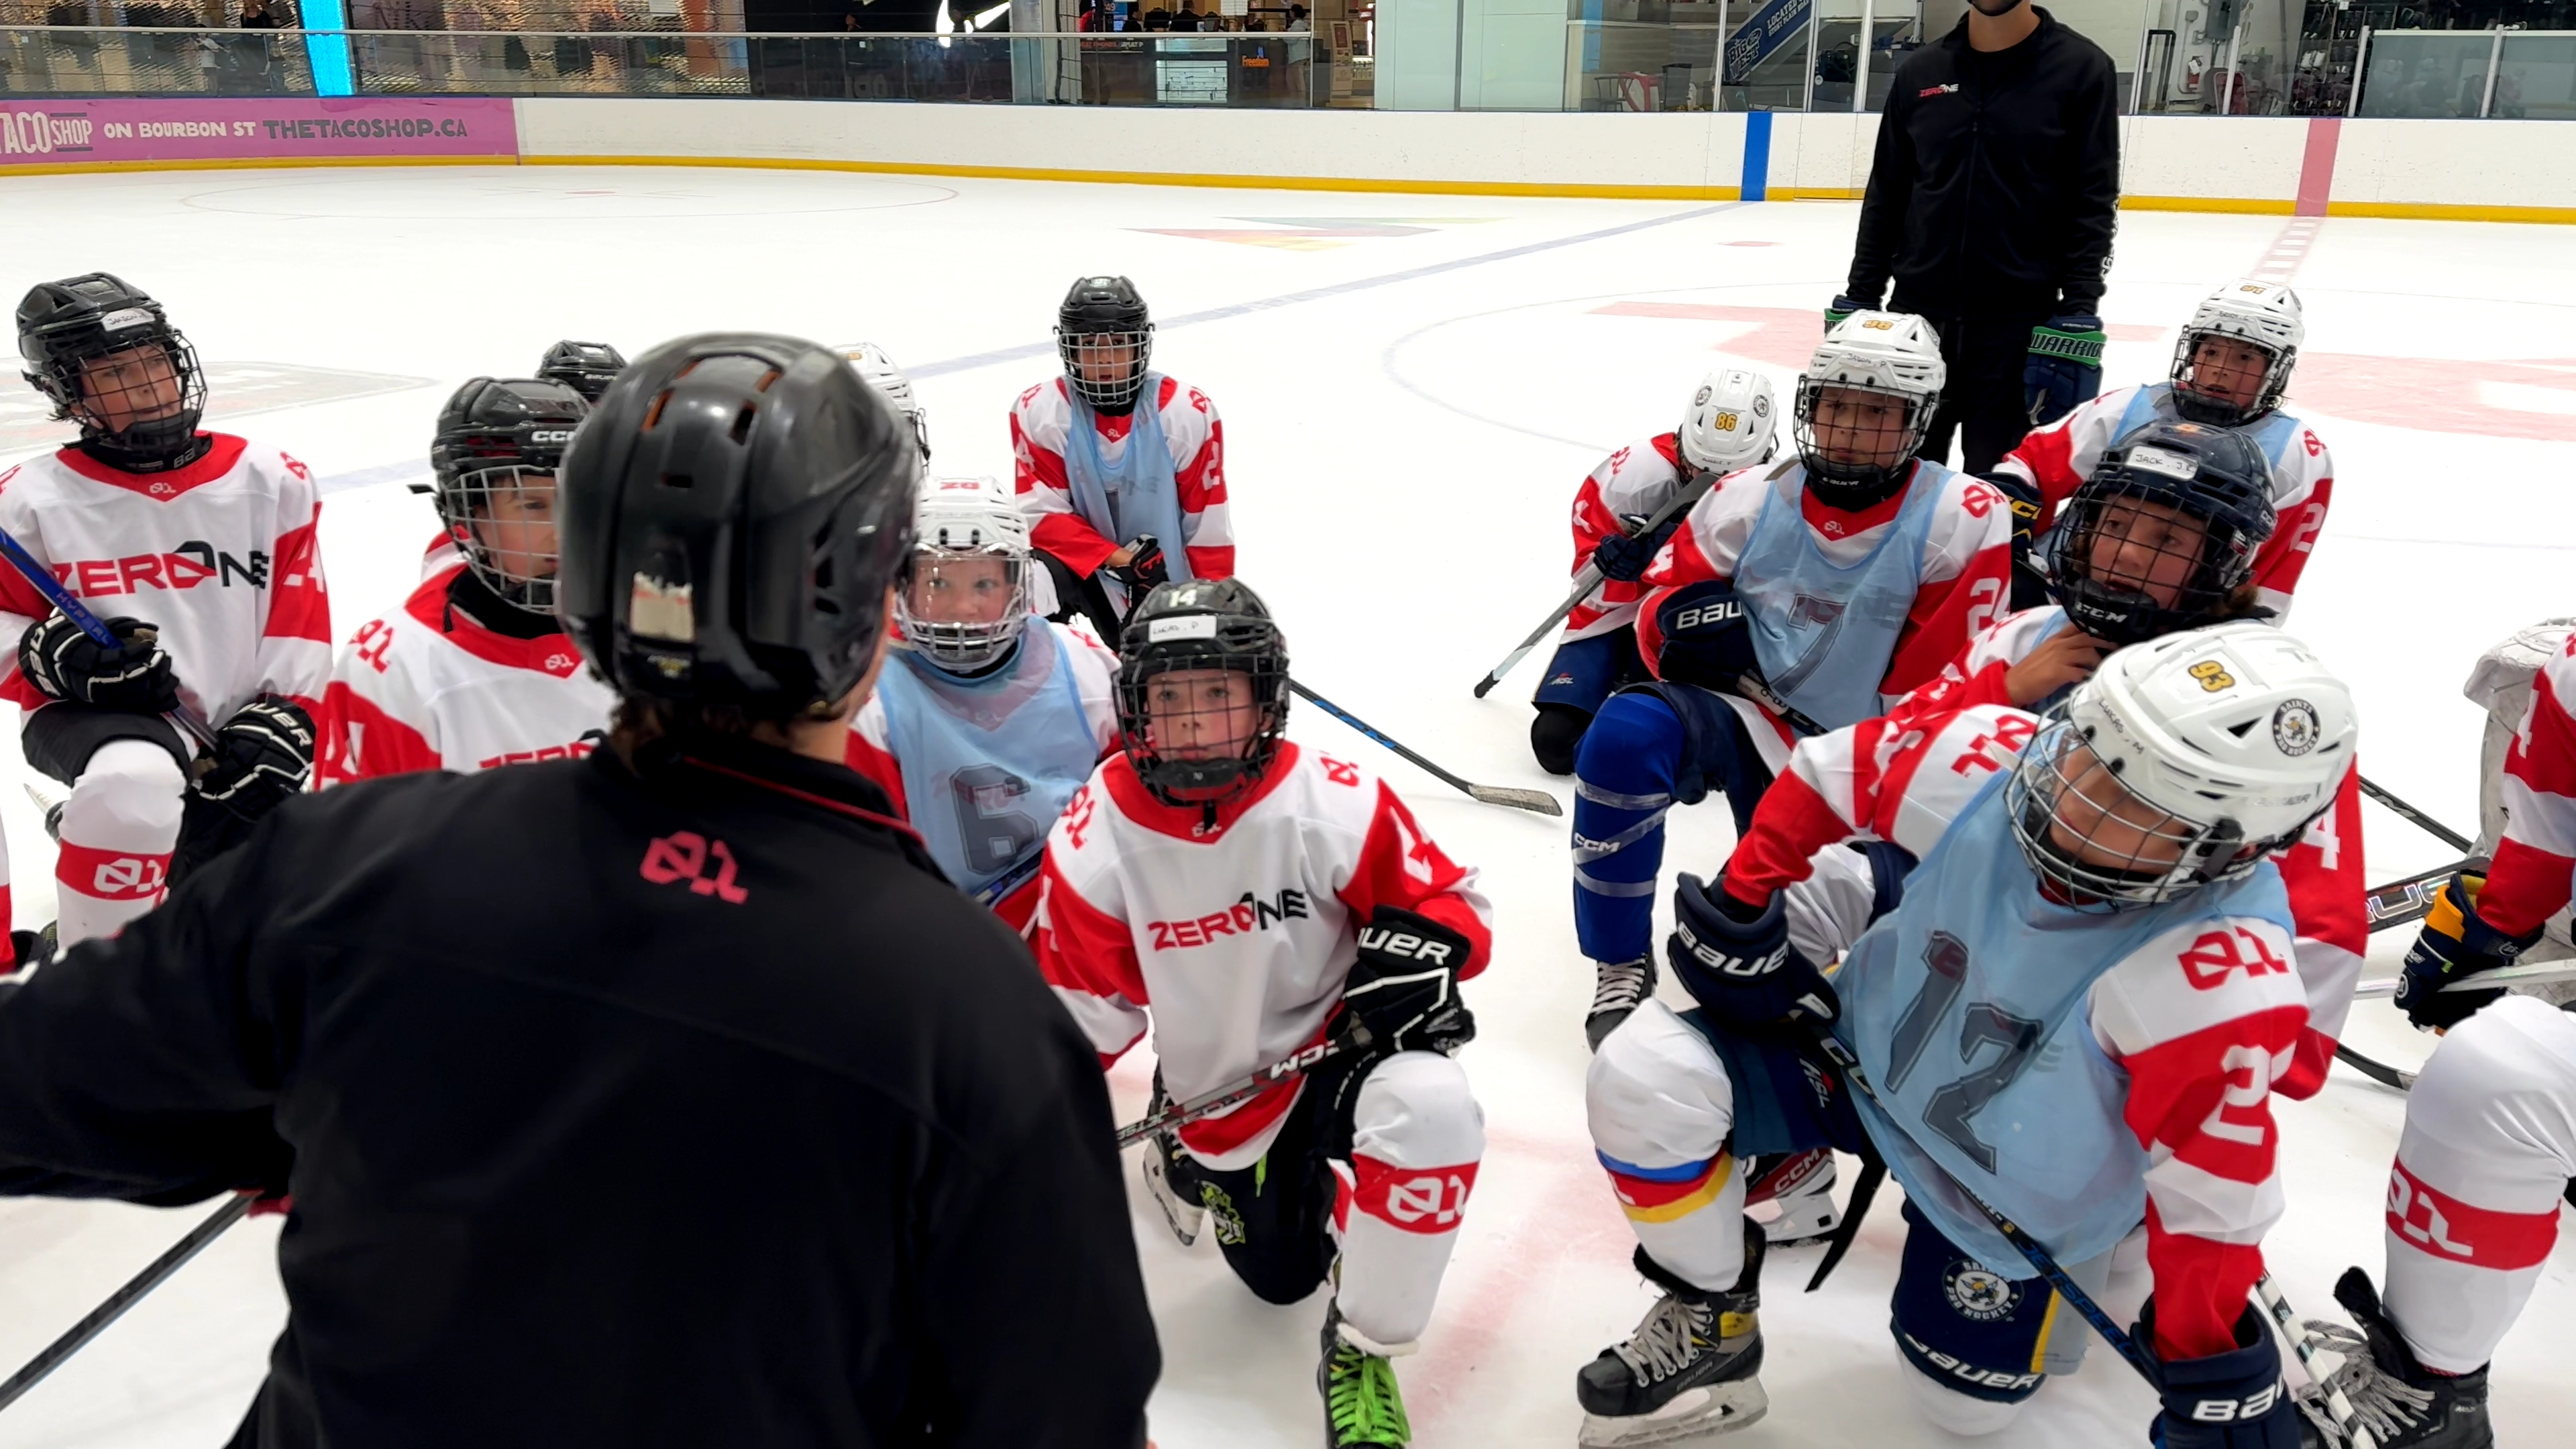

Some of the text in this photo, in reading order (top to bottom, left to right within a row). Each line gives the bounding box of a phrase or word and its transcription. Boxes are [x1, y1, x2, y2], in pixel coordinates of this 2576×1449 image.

[1727, 38, 1748, 64] BIG
[1729, 40, 1760, 78] WEST
[50, 119, 93, 146] SHOP
[104, 122, 133, 139] ON
[138, 121, 227, 139] BOURBON
[233, 121, 256, 138] ST
[262, 118, 468, 140] THETACOSHOP.CA
[1862, 320, 1894, 331] 98
[1715, 412, 1738, 431] 86
[2135, 454, 2163, 465] JACK
[1168, 589, 1197, 608] 14
[2076, 601, 2129, 624] CCM
[1770, 592, 1849, 699] 7
[2188, 659, 2237, 694] 93
[2280, 700, 2314, 713] SAINTS
[949, 763, 1038, 876] 6
[1574, 832, 1621, 853] CCM
[93, 857, 166, 894] 01
[639, 830, 749, 905] 01
[1357, 926, 1452, 966] UER
[1883, 930, 2045, 1176] 12
[1774, 1147, 1821, 1193] CCM
[1387, 1173, 1470, 1224] 01
[1946, 1285, 2013, 1320] PRO HOCKEY
[2015, 1240, 2139, 1360] JETSPEED
